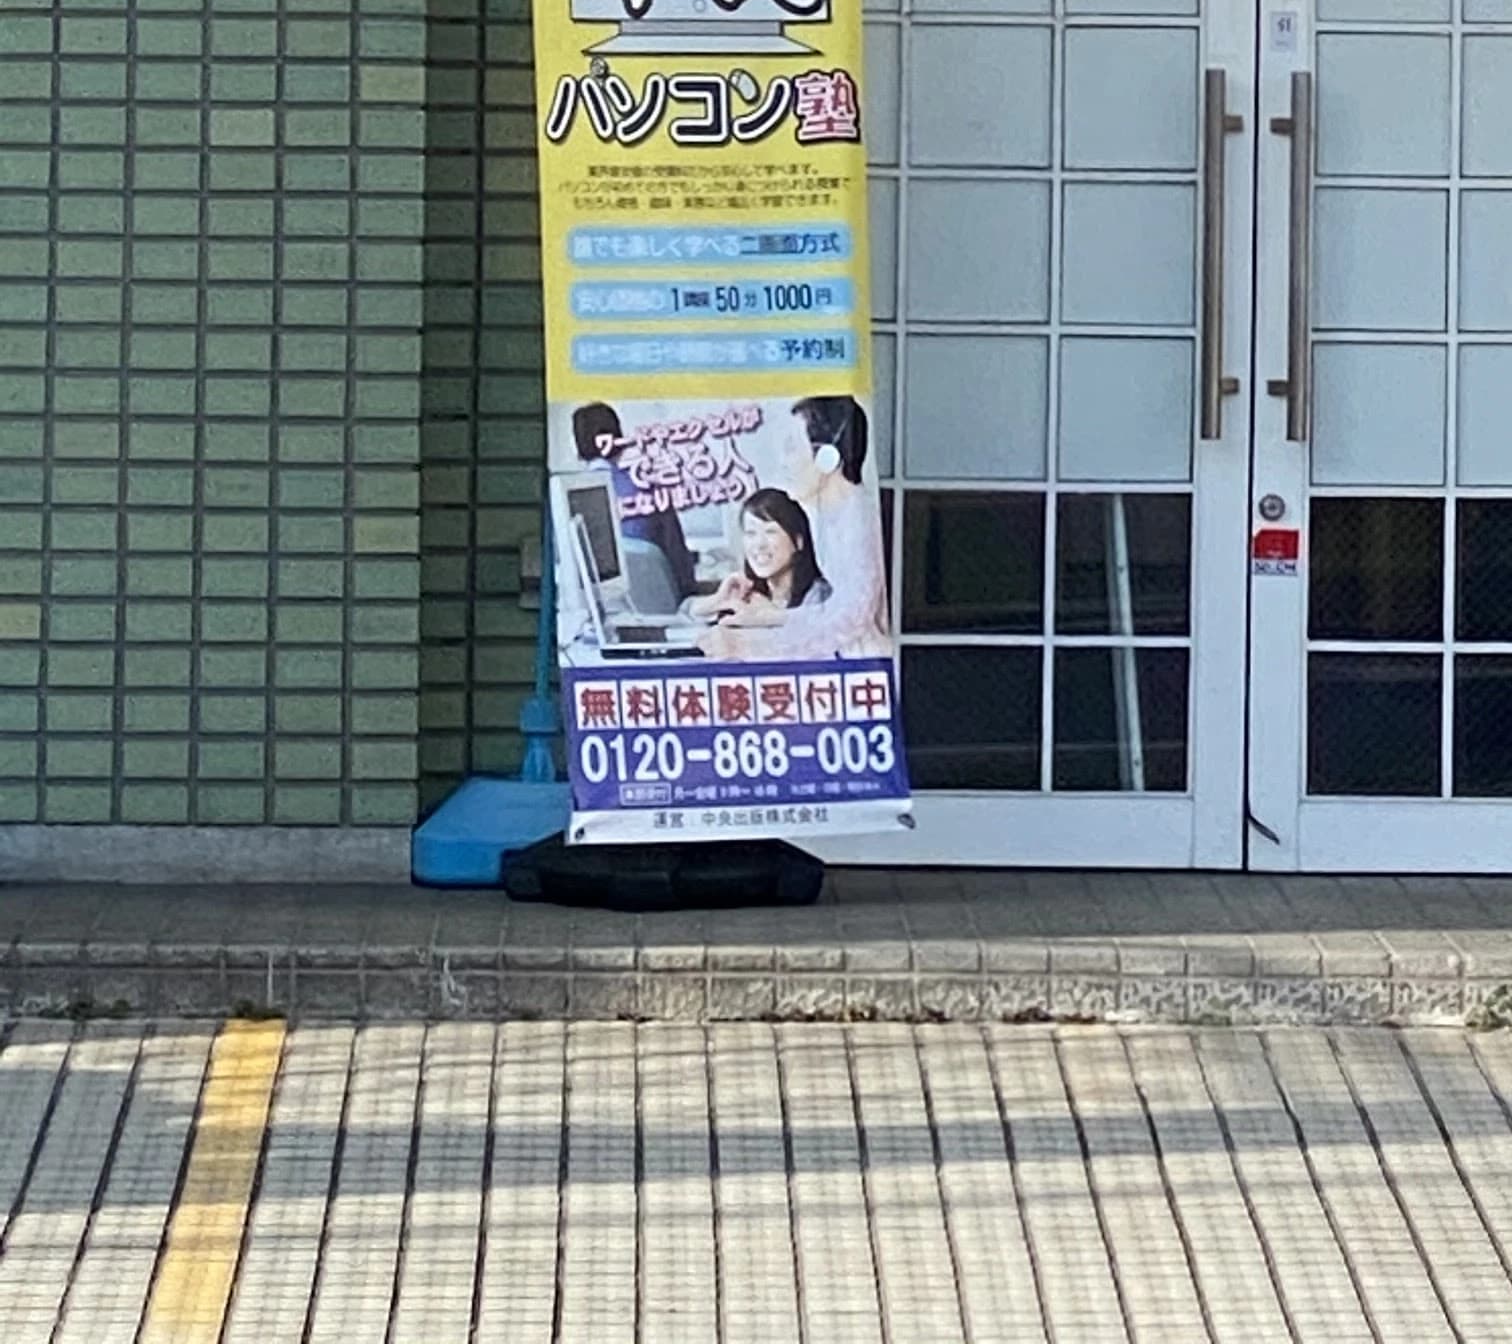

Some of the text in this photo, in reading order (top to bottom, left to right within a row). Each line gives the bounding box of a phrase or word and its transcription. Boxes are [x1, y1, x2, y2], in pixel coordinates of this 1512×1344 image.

[545, 68, 862, 146] パソコン塾
[580, 677, 887, 726] 無料体験受付中
[580, 724, 896, 783] 0120-868-003
